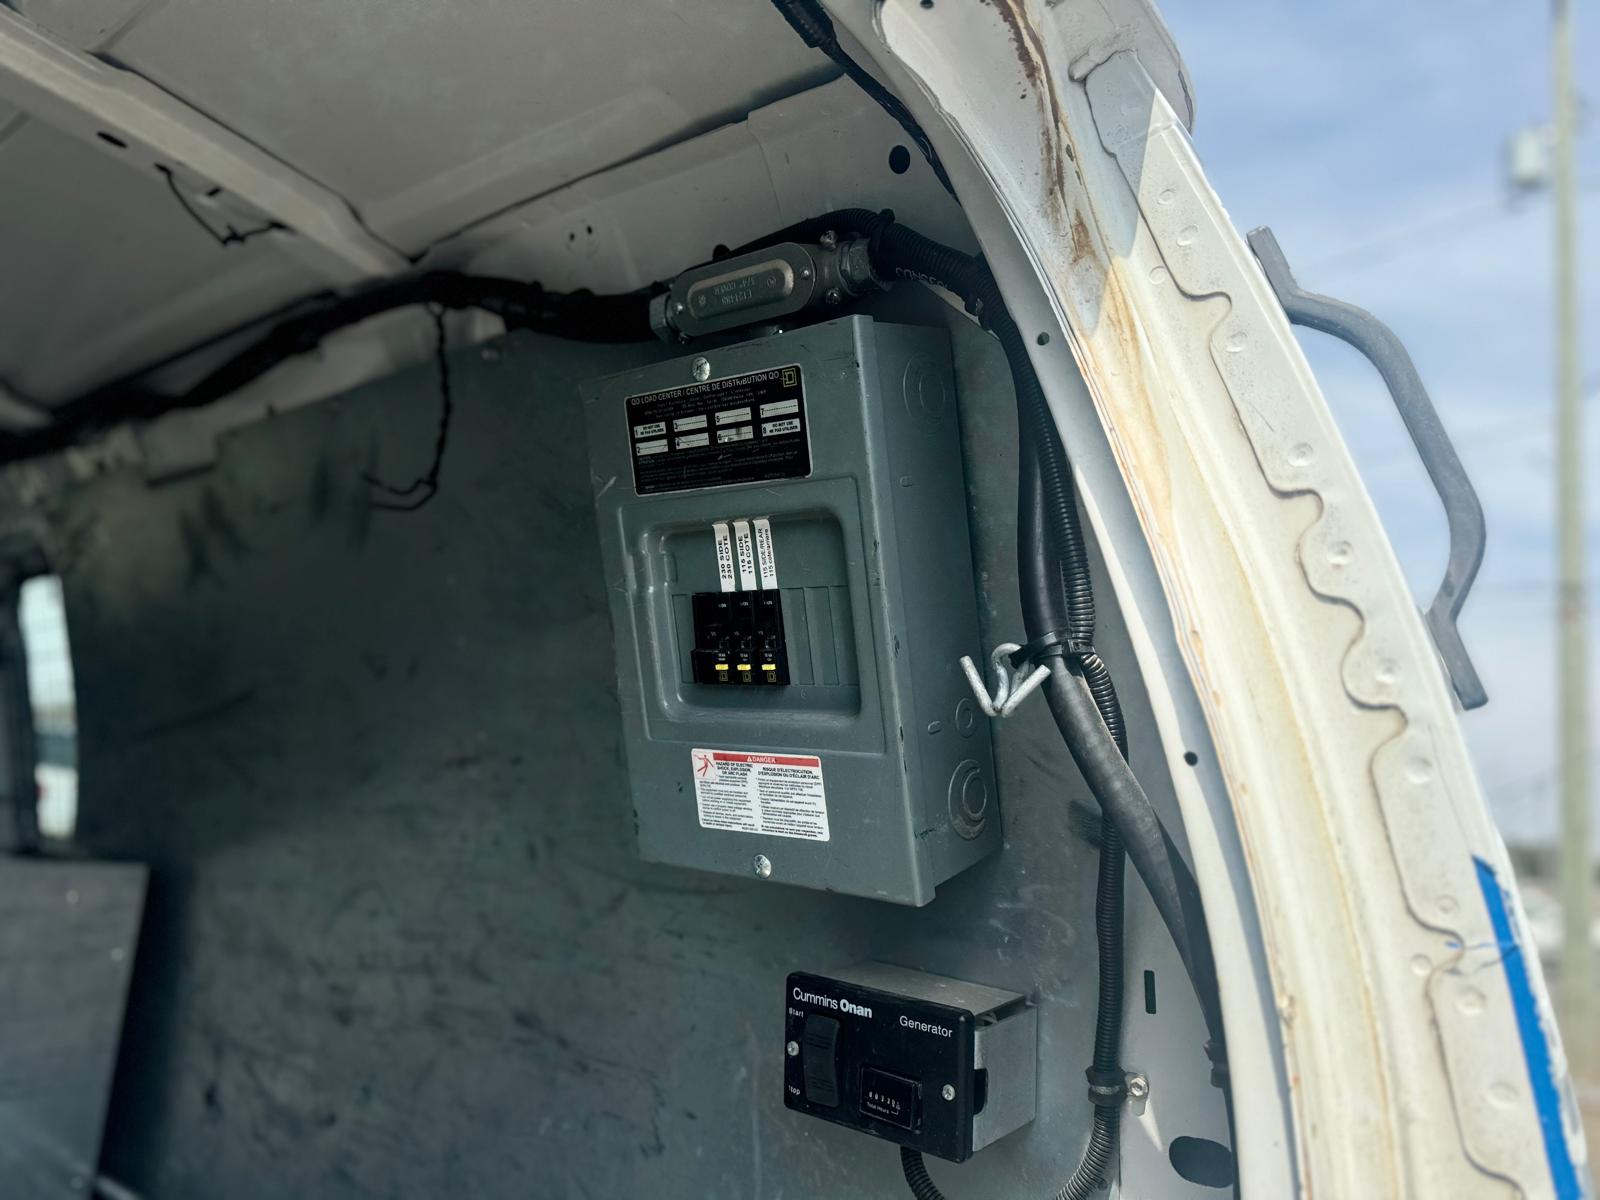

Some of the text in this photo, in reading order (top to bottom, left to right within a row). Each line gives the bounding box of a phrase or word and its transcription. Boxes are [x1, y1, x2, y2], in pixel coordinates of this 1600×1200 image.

[641, 394, 656, 404] LOAD
[658, 390, 682, 400] CENTER
[686, 384, 710, 396] CENTRE
[712, 382, 720, 390] DE
[722, 373, 767, 388] DISTRIBUTION
[768, 371, 780, 380] QO
[758, 528, 767, 565] SIDE/REAR
[793, 987, 872, 1018] Cummins Onan
[900, 1015, 952, 1038] Generator
